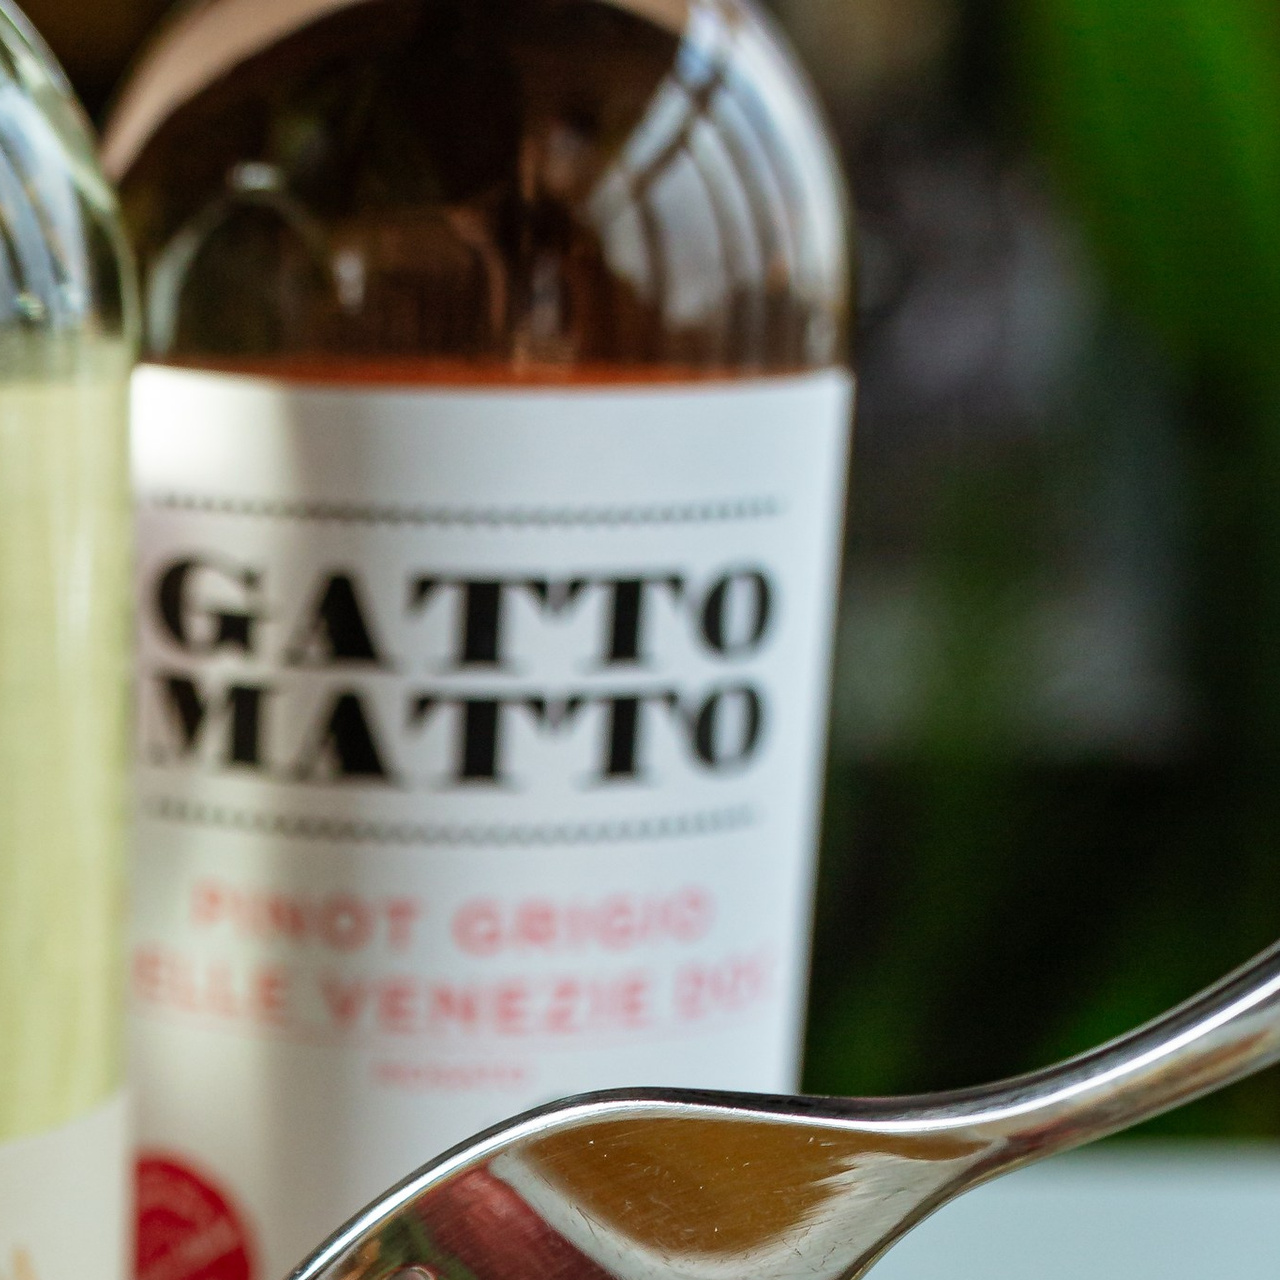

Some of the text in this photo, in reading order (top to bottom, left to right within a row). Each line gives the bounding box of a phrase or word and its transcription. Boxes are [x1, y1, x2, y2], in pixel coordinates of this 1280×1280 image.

[151, 552, 776, 671] GATTO
[146, 671, 764, 791] MATTO
[194, 883, 714, 956] PINOT GRIGIO
[131, 945, 289, 1029] ELLE
[324, 972, 652, 1035] VENEZIE
